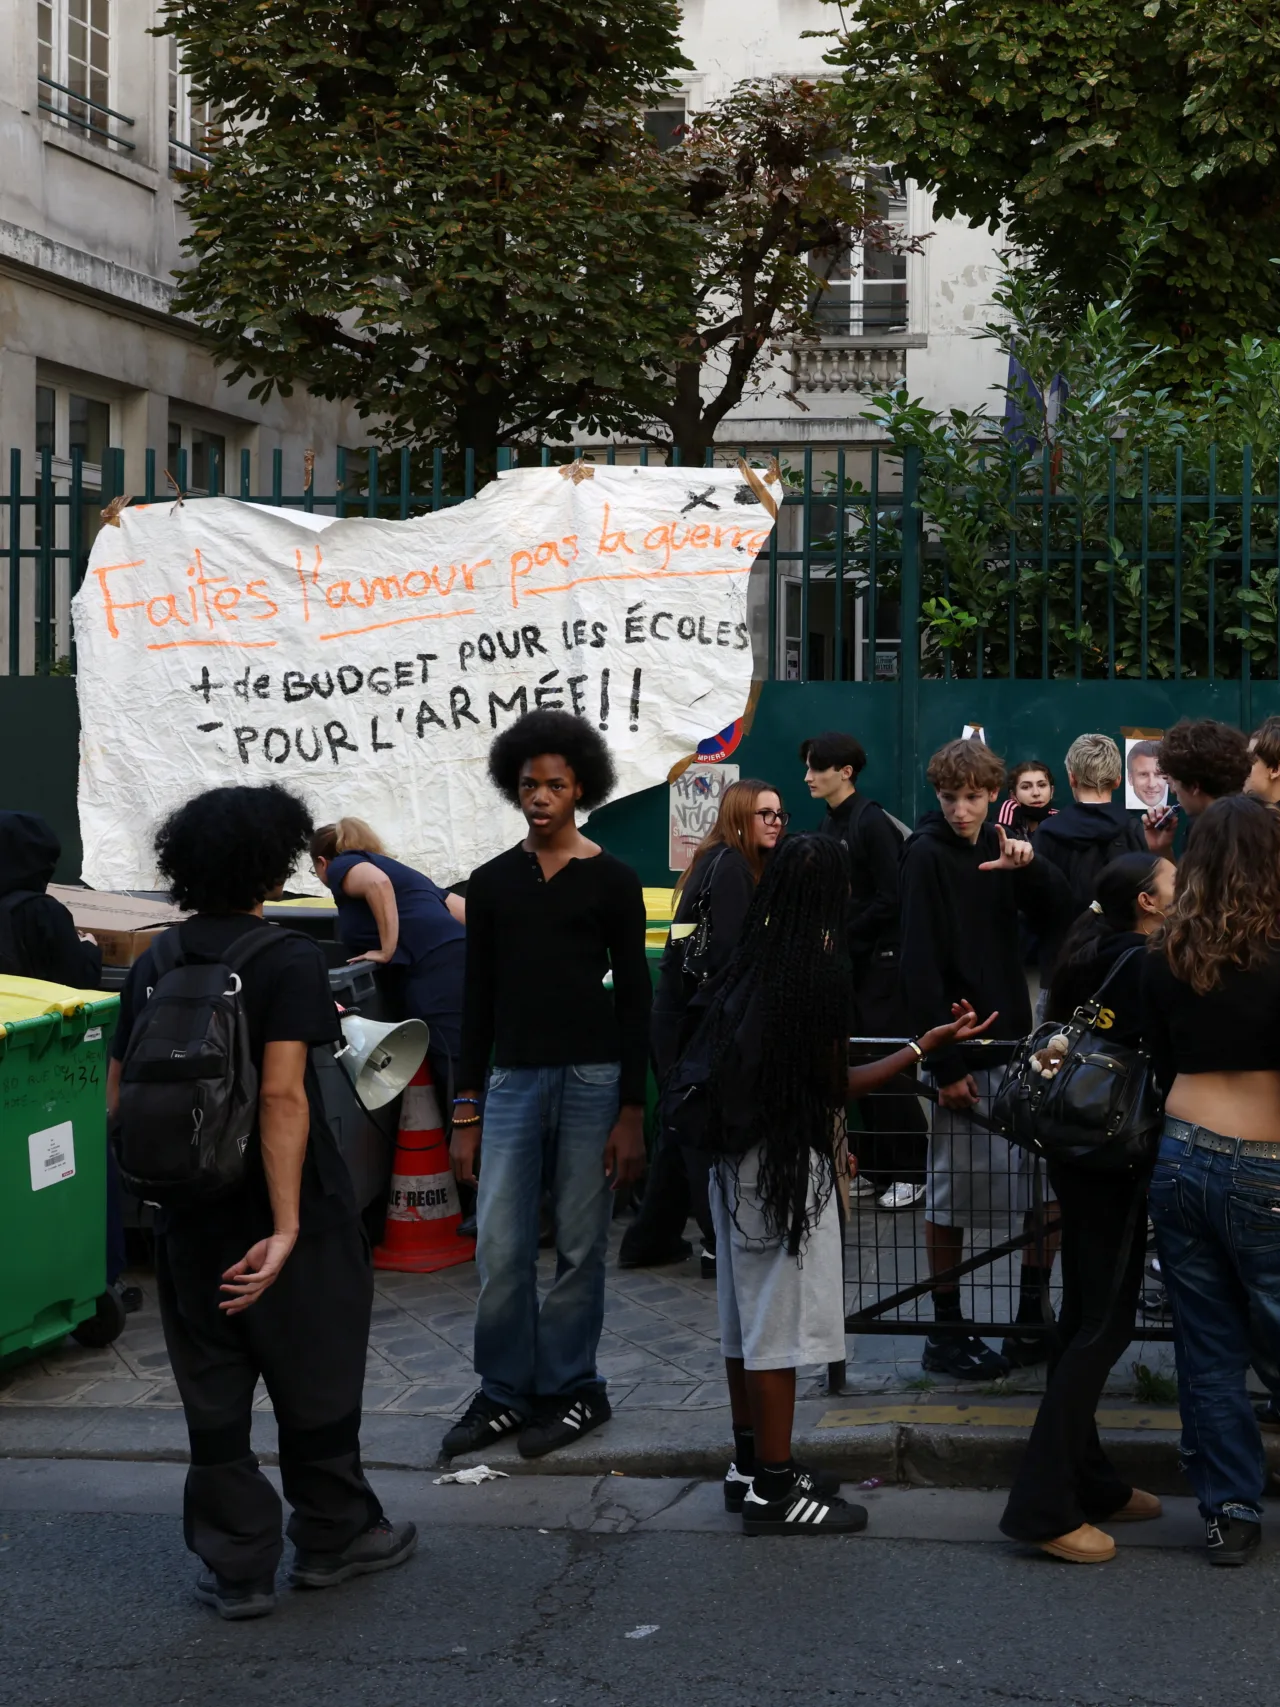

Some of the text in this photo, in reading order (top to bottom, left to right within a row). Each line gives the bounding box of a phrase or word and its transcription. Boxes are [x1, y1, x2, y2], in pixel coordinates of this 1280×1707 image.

[93, 548, 278, 638] Faites
[296, 545, 491, 621] l'amour
[511, 535, 579, 608] pas
[597, 502, 633, 556] la
[234, 665, 270, 703] de
[284, 653, 440, 703] BUDGET
[459, 625, 548, 672] POUR
[562, 620, 608, 650] LES
[625, 600, 748, 650] ÉCOLES
[234, 720, 359, 765] POUR
[698, 752, 726, 761] MPIERS
